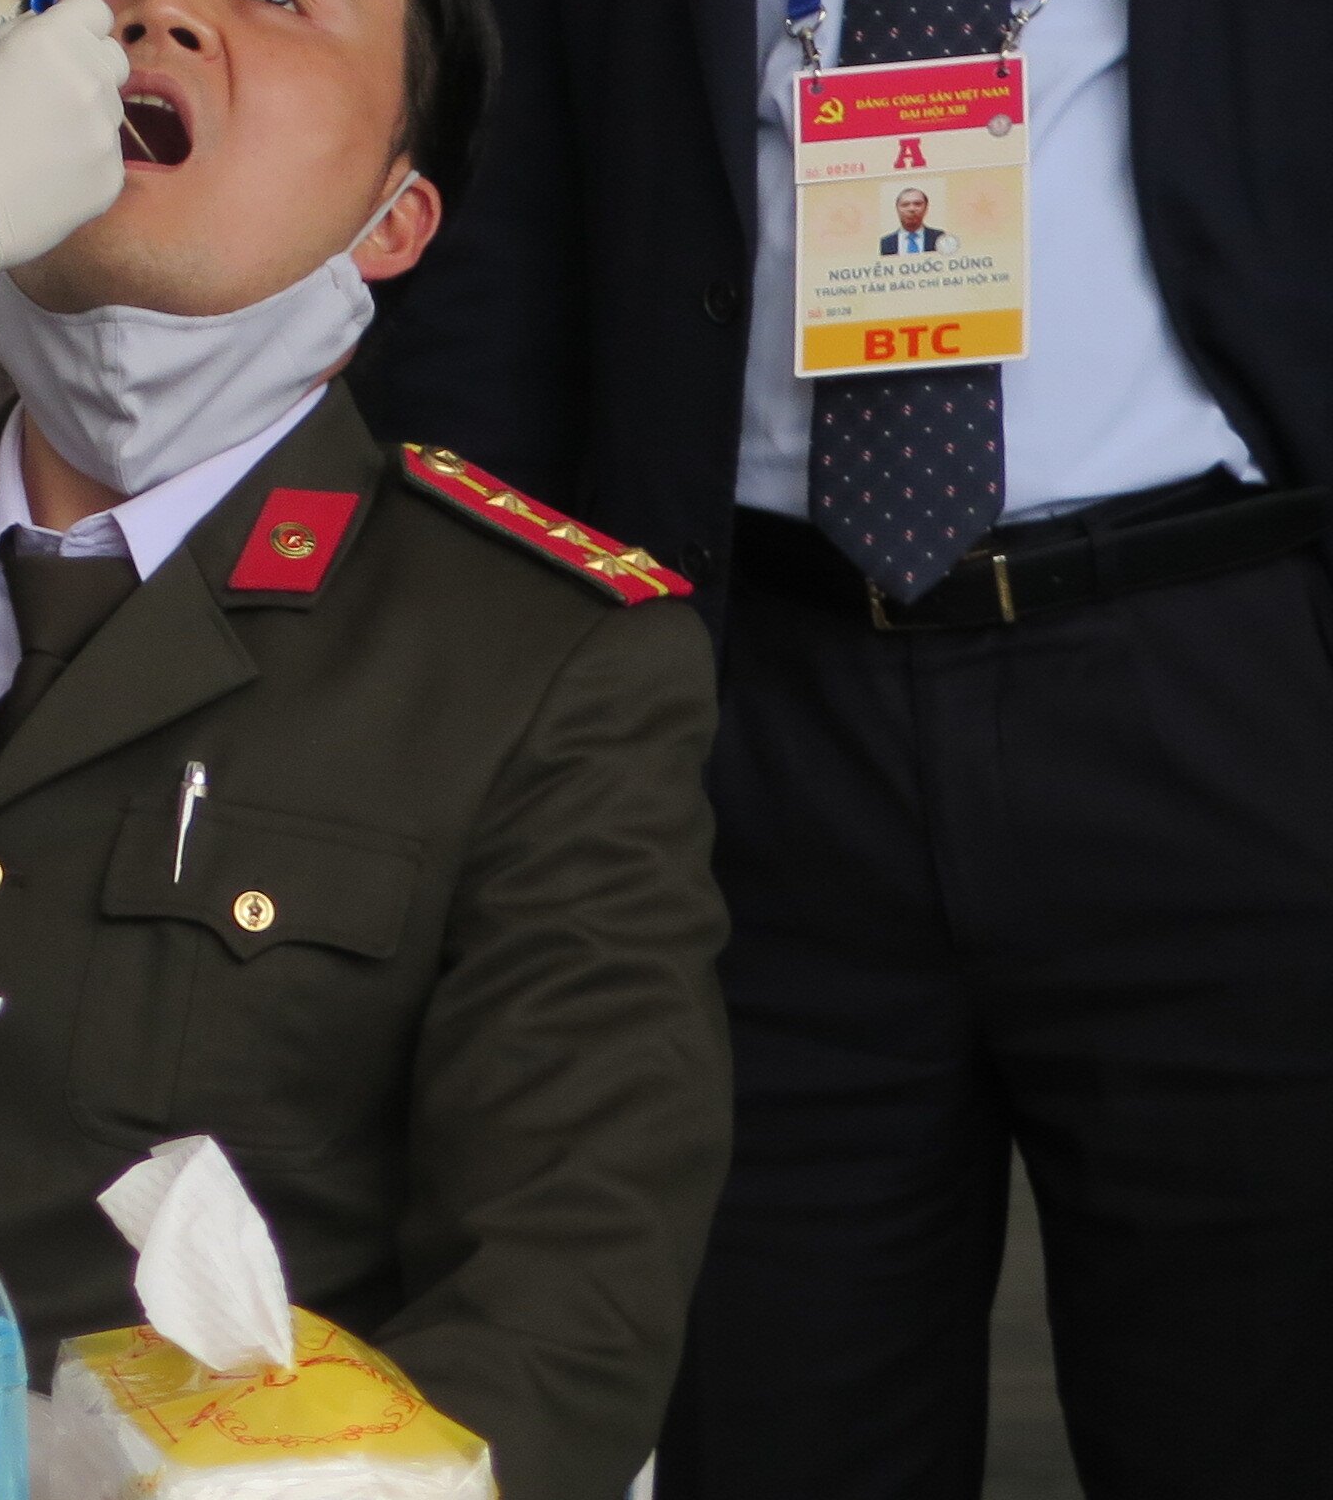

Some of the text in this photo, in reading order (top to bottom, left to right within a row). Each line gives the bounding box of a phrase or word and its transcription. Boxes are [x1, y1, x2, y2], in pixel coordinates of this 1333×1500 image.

[982, 86, 1010, 98] NAM
[893, 138, 926, 169] A
[815, 284, 857, 297] TRUNG
[863, 322, 961, 362] BTC
